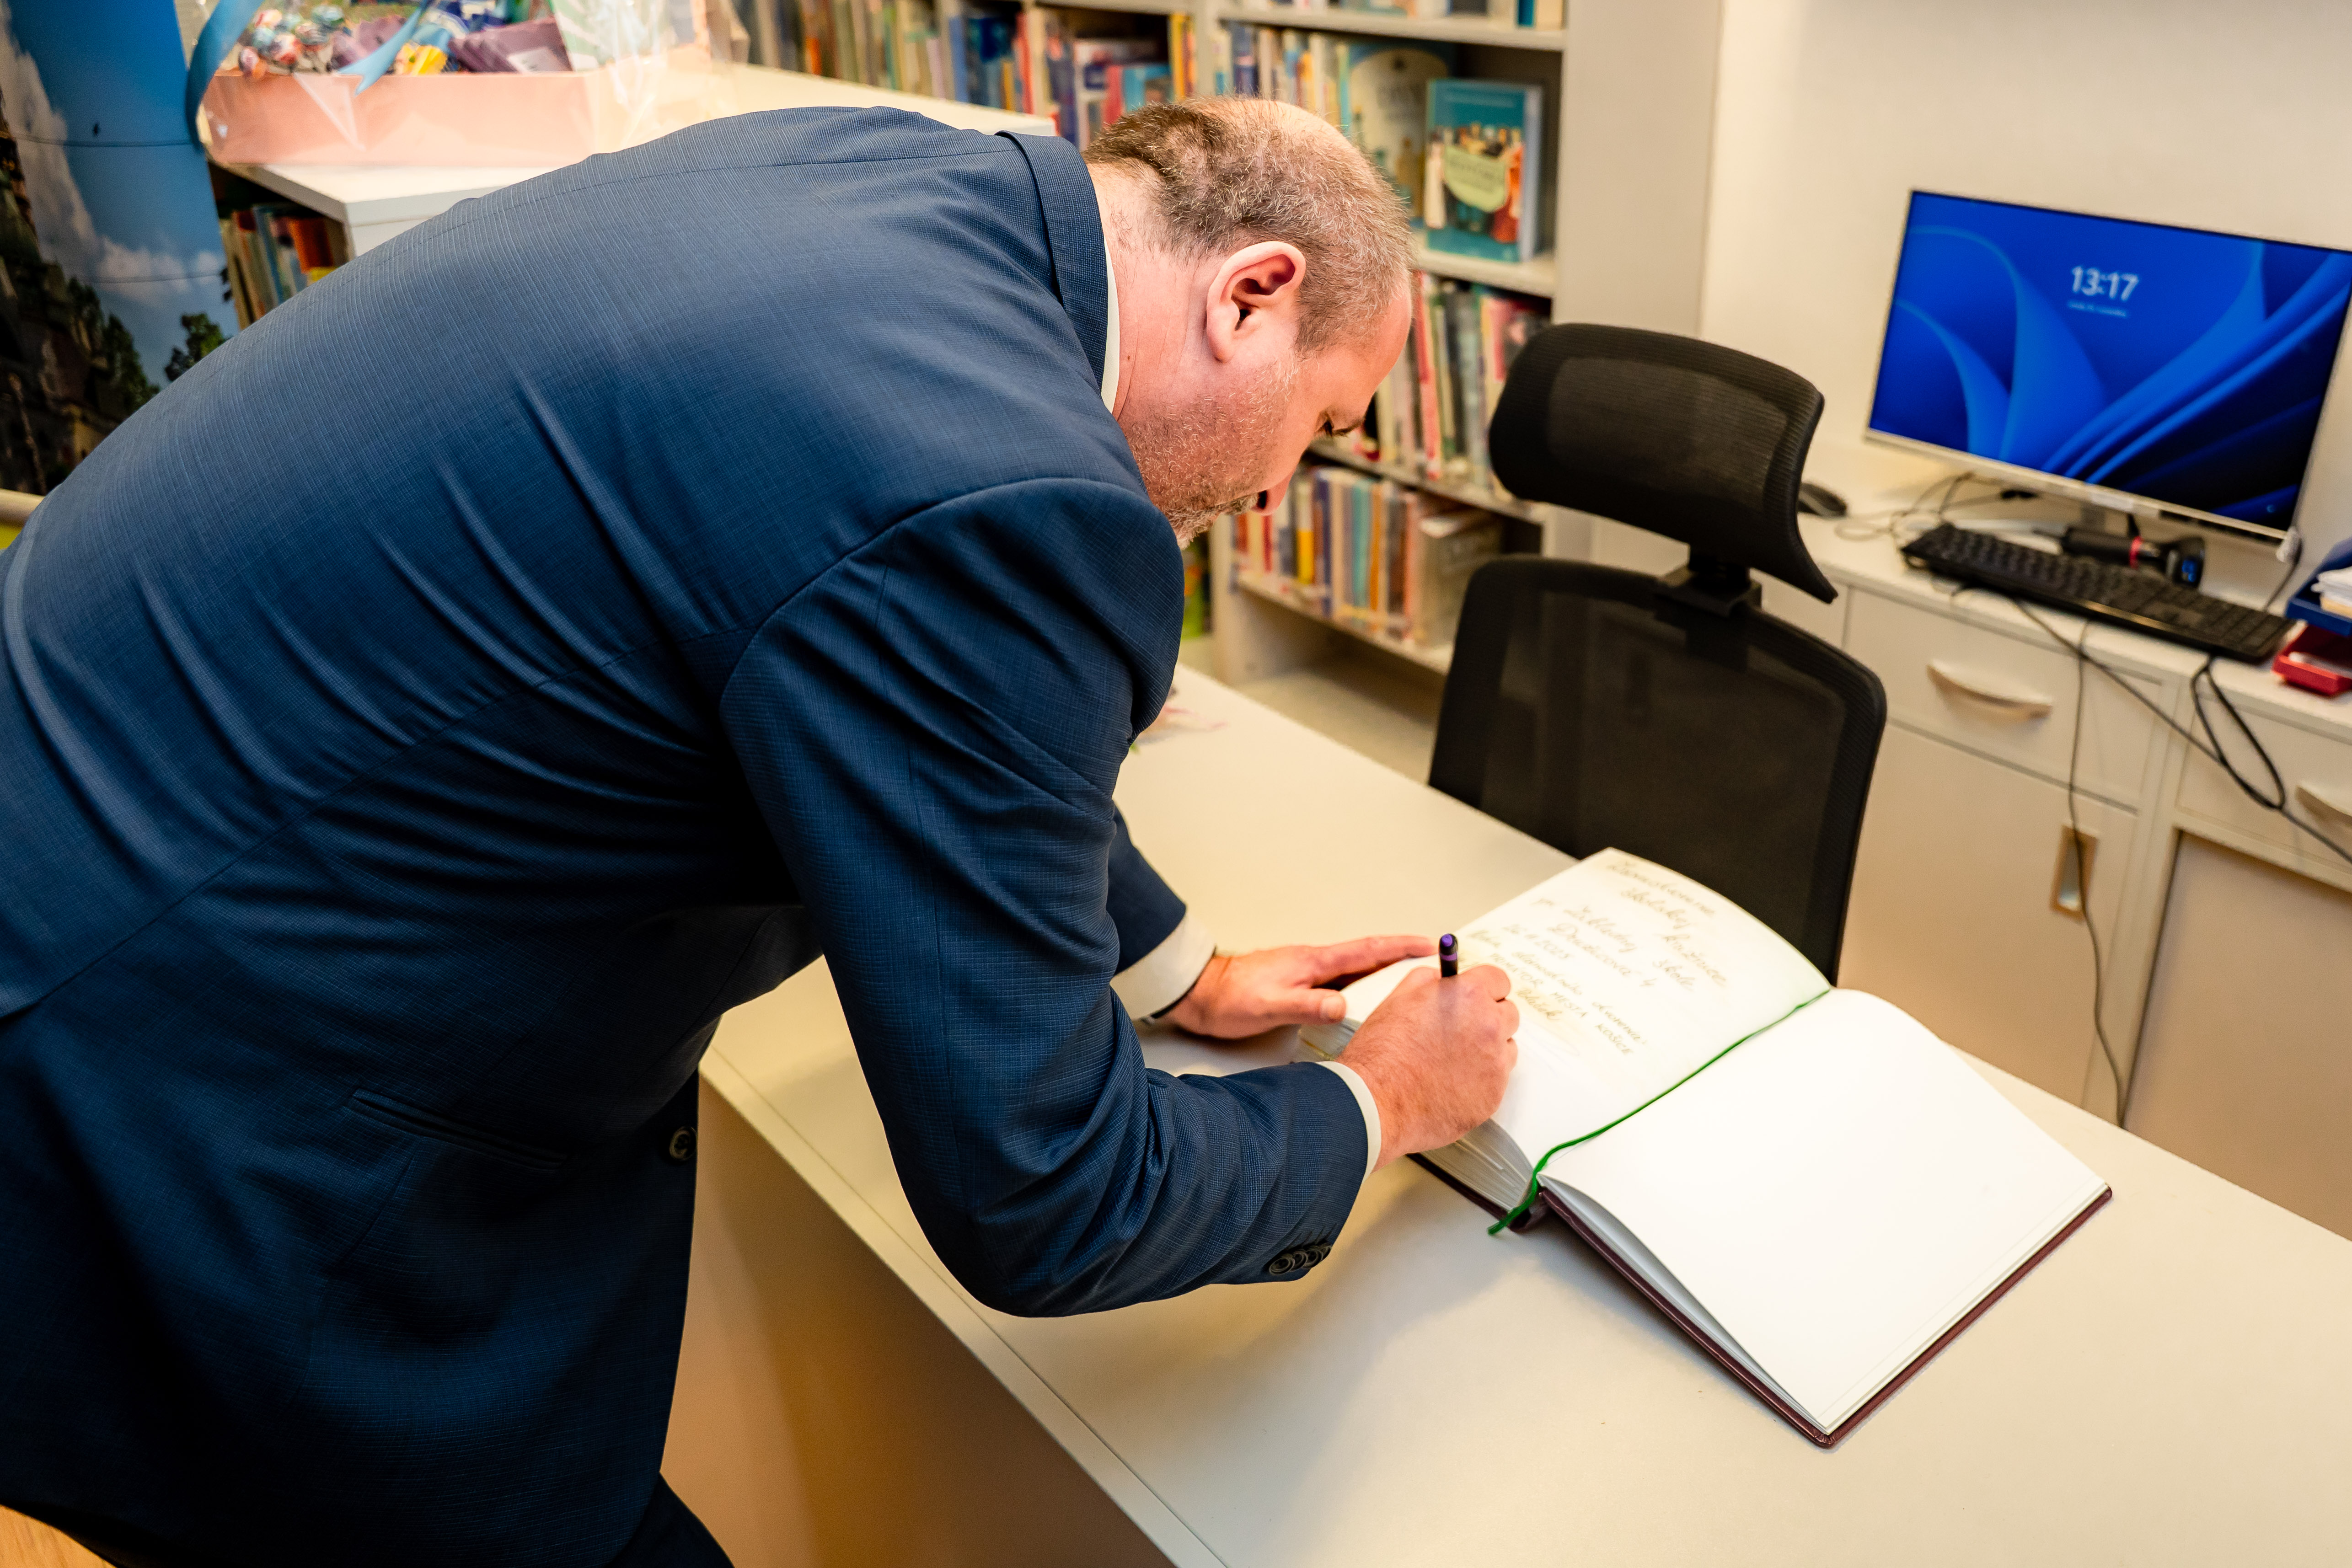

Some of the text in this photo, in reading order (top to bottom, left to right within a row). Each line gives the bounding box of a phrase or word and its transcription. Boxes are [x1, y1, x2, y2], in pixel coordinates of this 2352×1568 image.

[2072, 266, 2138, 300] 13:17
[1549, 990, 1589, 1019] MESTA
[1594, 1022, 1634, 1055] KOŠICE
